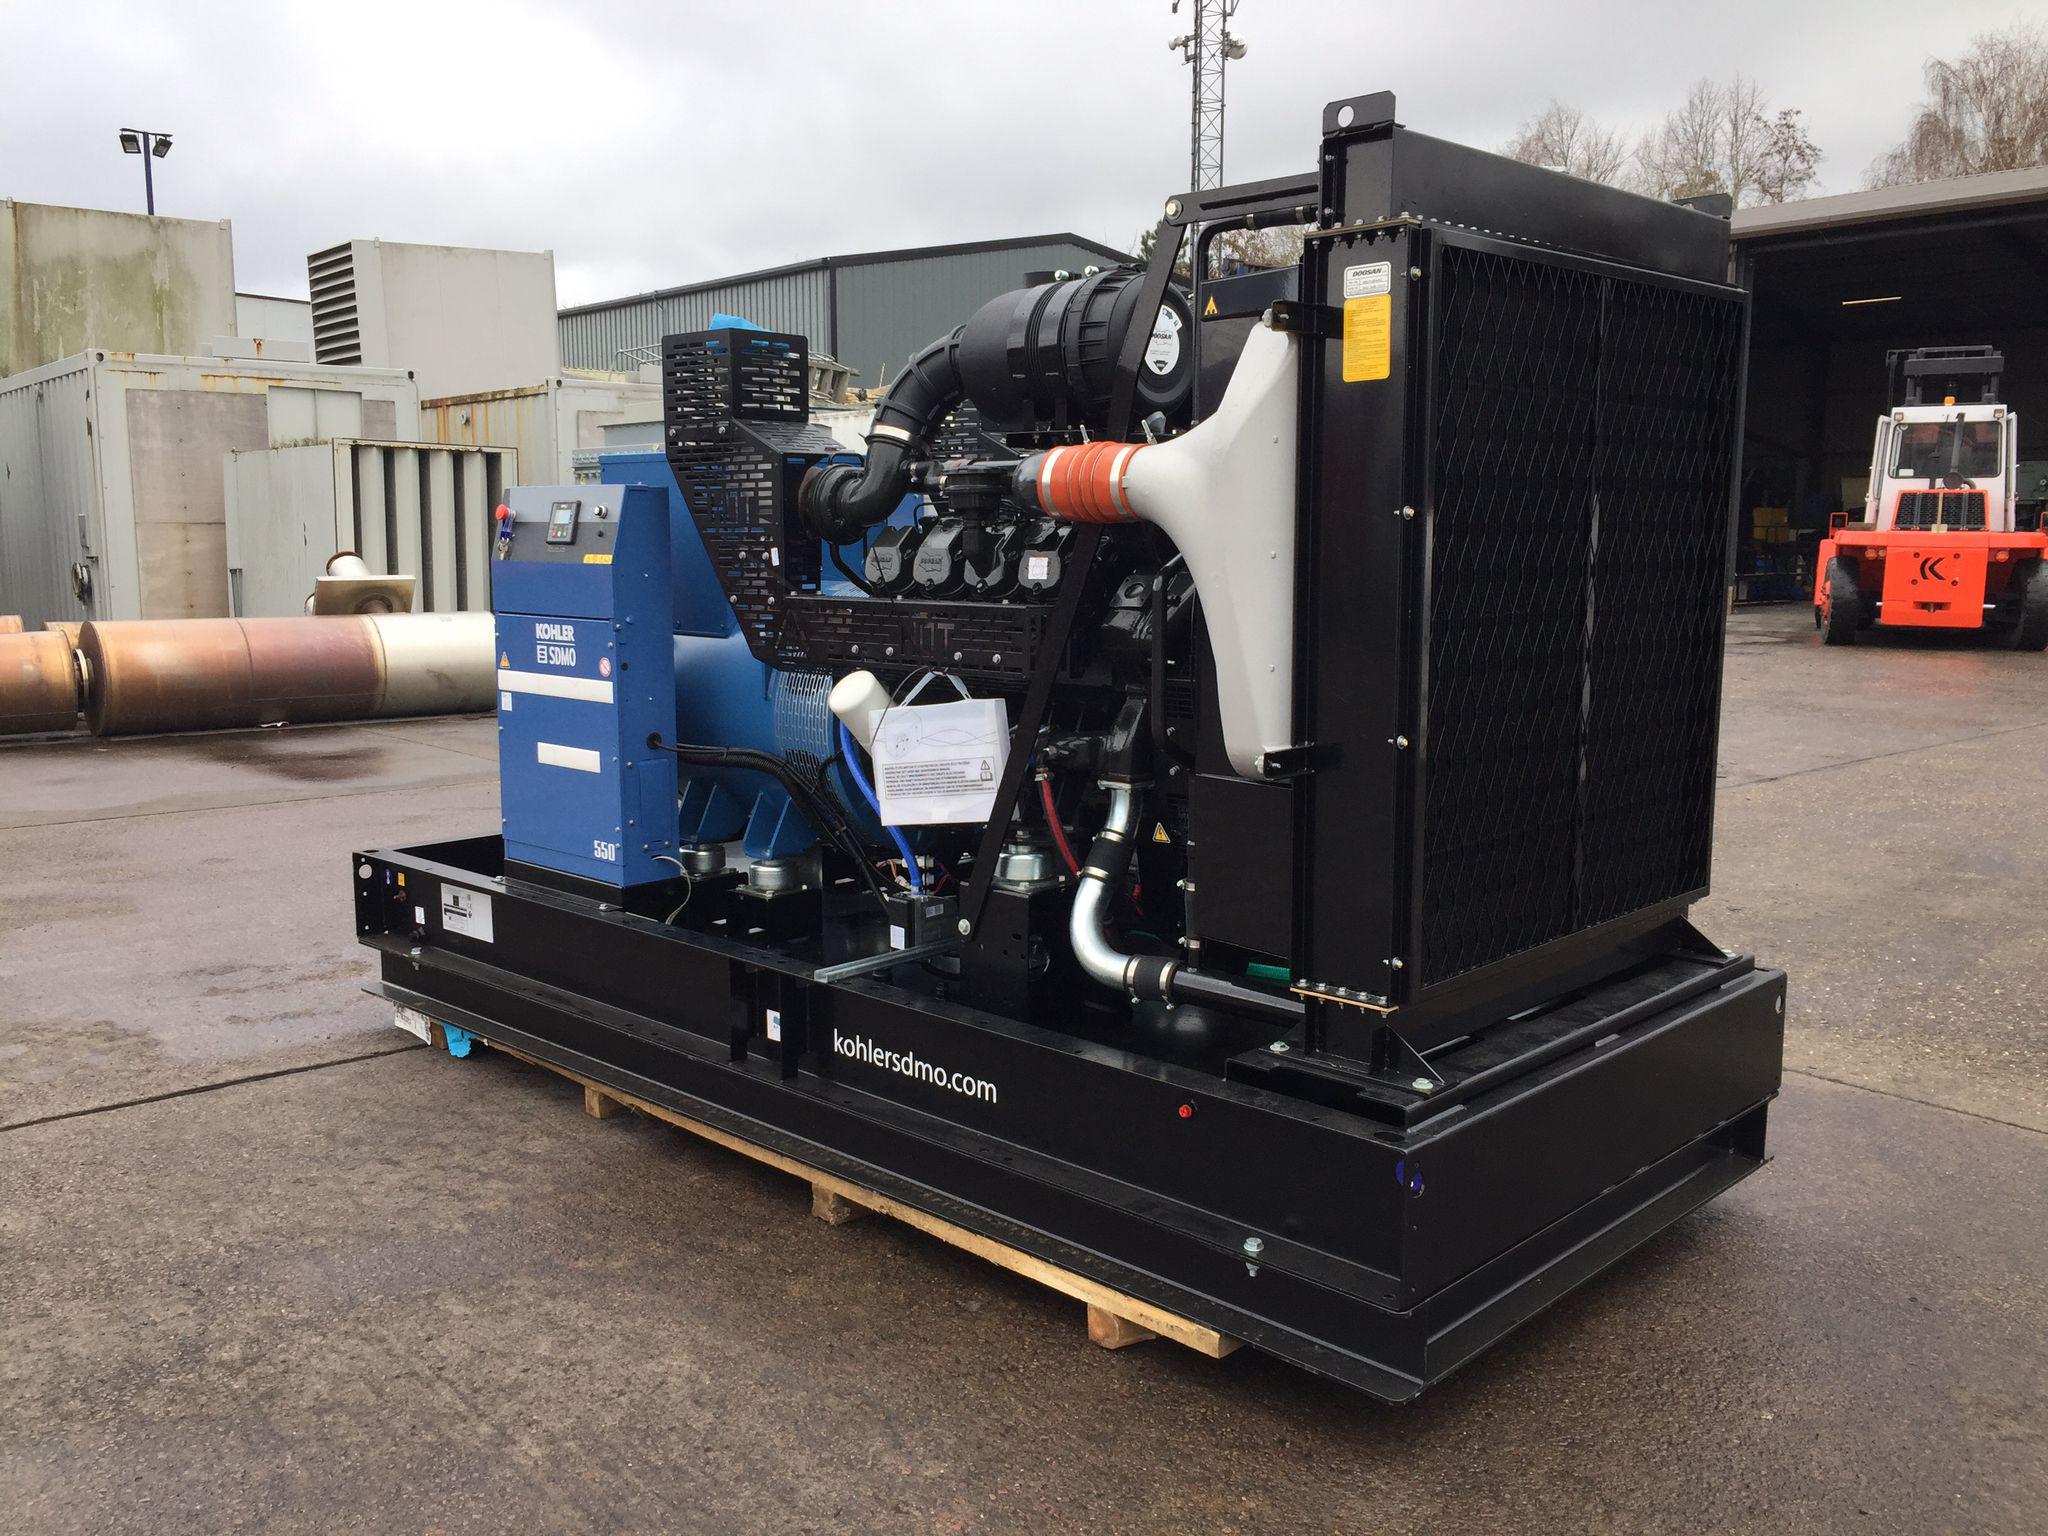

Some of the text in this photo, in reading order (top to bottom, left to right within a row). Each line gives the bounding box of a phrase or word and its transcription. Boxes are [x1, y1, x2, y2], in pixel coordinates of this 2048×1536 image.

[1352, 267, 1383, 278] DOOSAN
[535, 622, 576, 642] KOHLER
[548, 646, 577, 667] SDMO
[592, 839, 617, 862] 550
[832, 1027, 998, 1104] kohlersdmo.com
